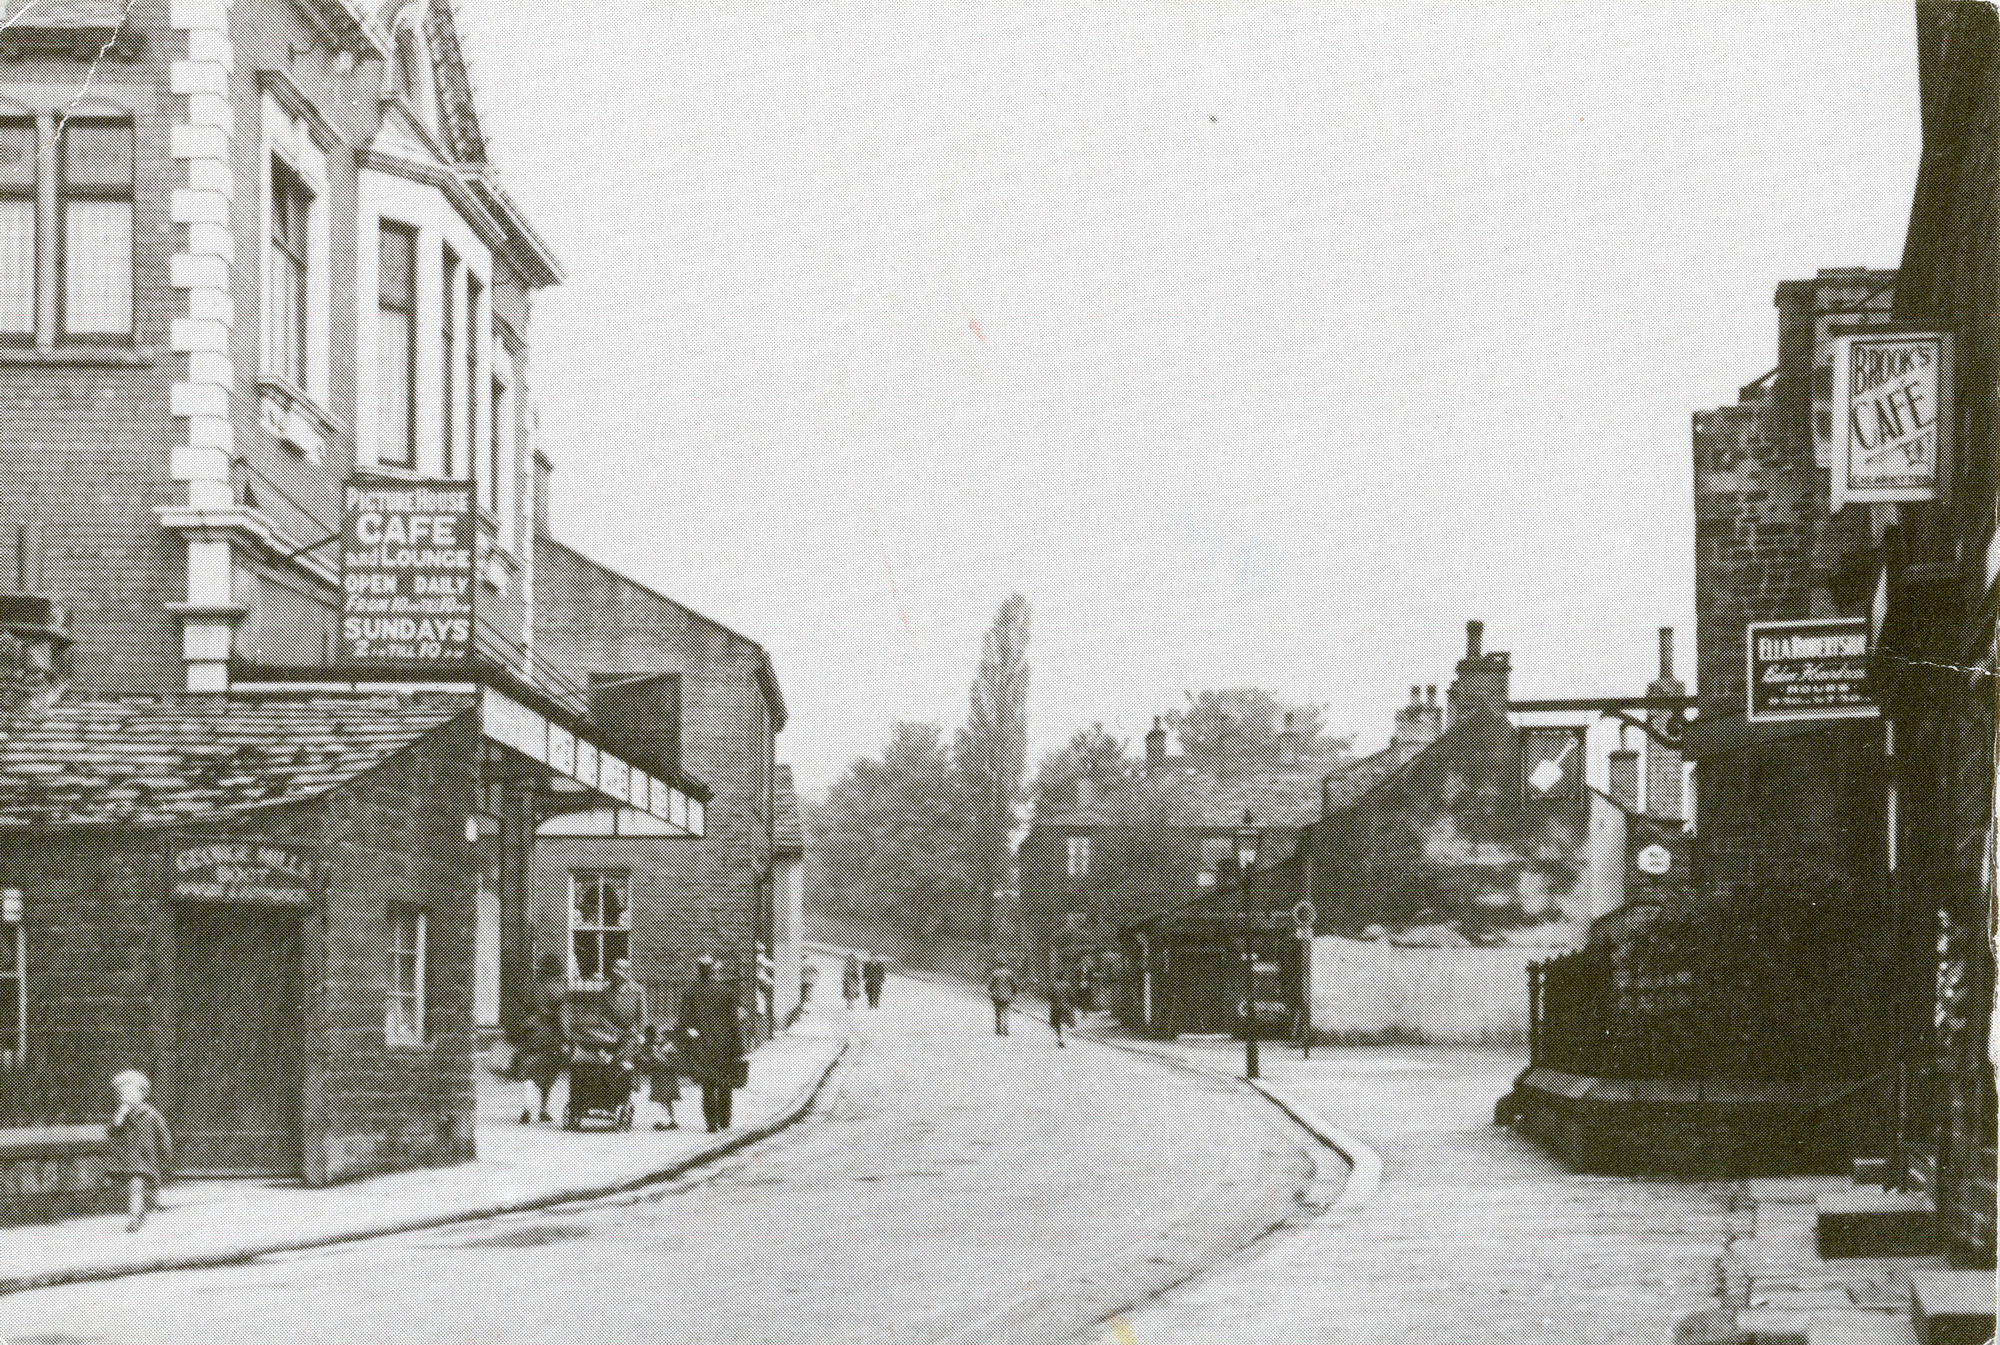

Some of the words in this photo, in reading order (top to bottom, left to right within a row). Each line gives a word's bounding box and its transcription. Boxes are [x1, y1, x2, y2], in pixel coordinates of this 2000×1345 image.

[1854, 345, 1931, 396] BROOK'S
[346, 486, 415, 512] PICTURE
[416, 487, 469, 513] HOUSE
[356, 512, 457, 545] CAFE
[380, 545, 471, 568] LOUNGE
[344, 573, 397, 594] OPEN
[414, 575, 469, 595] DAILY
[344, 617, 470, 642] SUNDAYS
[353, 639, 369, 658] 2
[418, 641, 441, 659] 10
[1786, 683, 1850, 694] HOURS
[216, 866, 271, 882] BOOT
